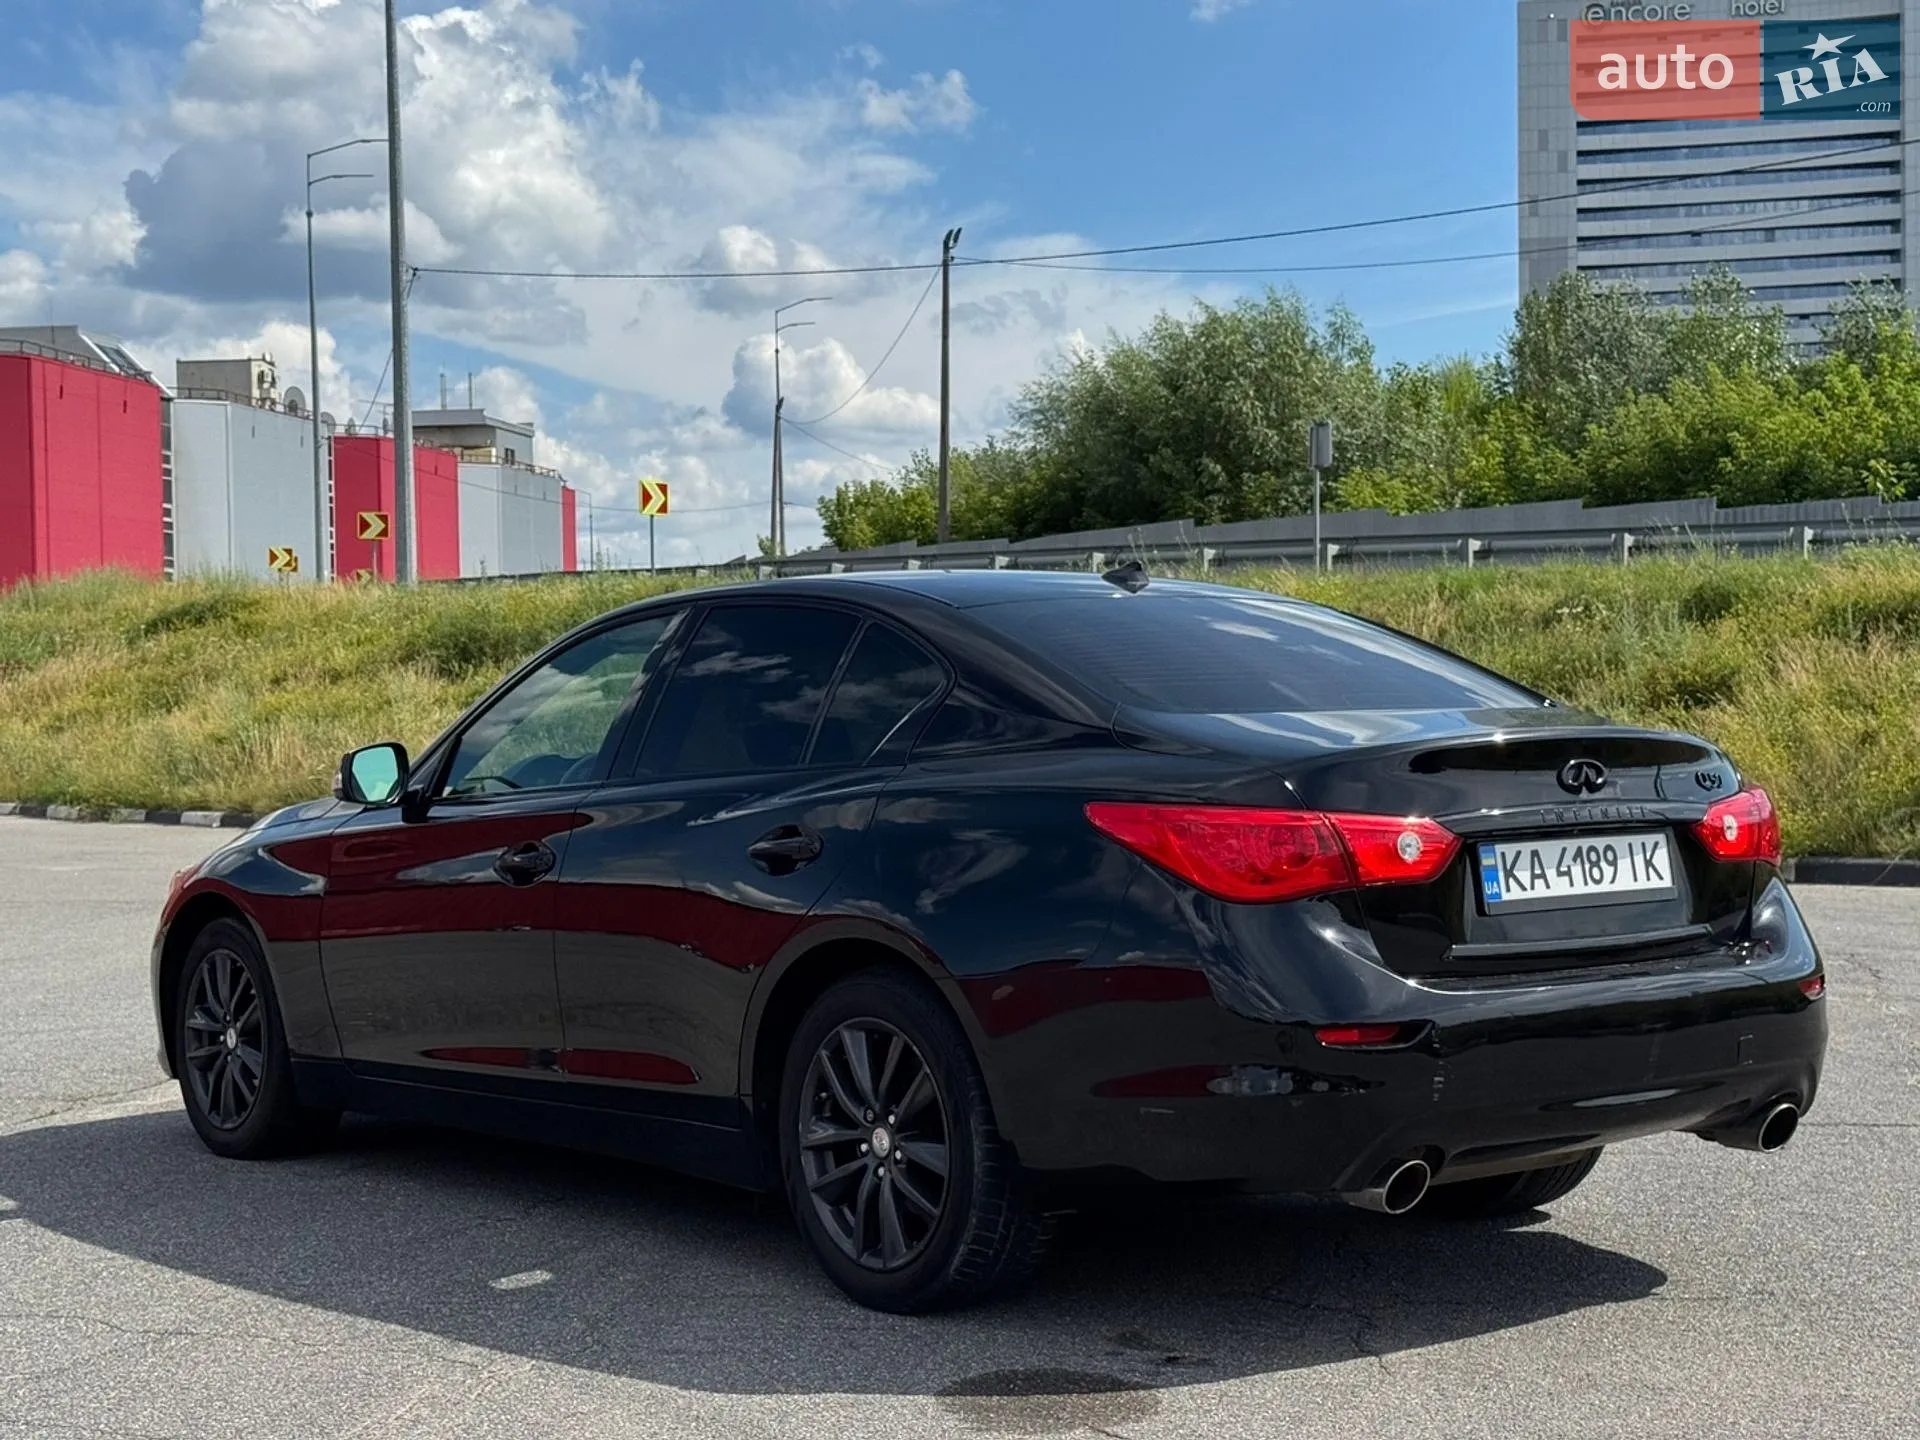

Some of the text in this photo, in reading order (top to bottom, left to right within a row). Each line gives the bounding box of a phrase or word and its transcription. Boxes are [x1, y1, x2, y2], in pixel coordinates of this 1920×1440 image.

[1731, 0, 1785, 16] hotel
[1501, 841, 1664, 893] KA 4189 IK
[1485, 881, 1499, 894] UA
